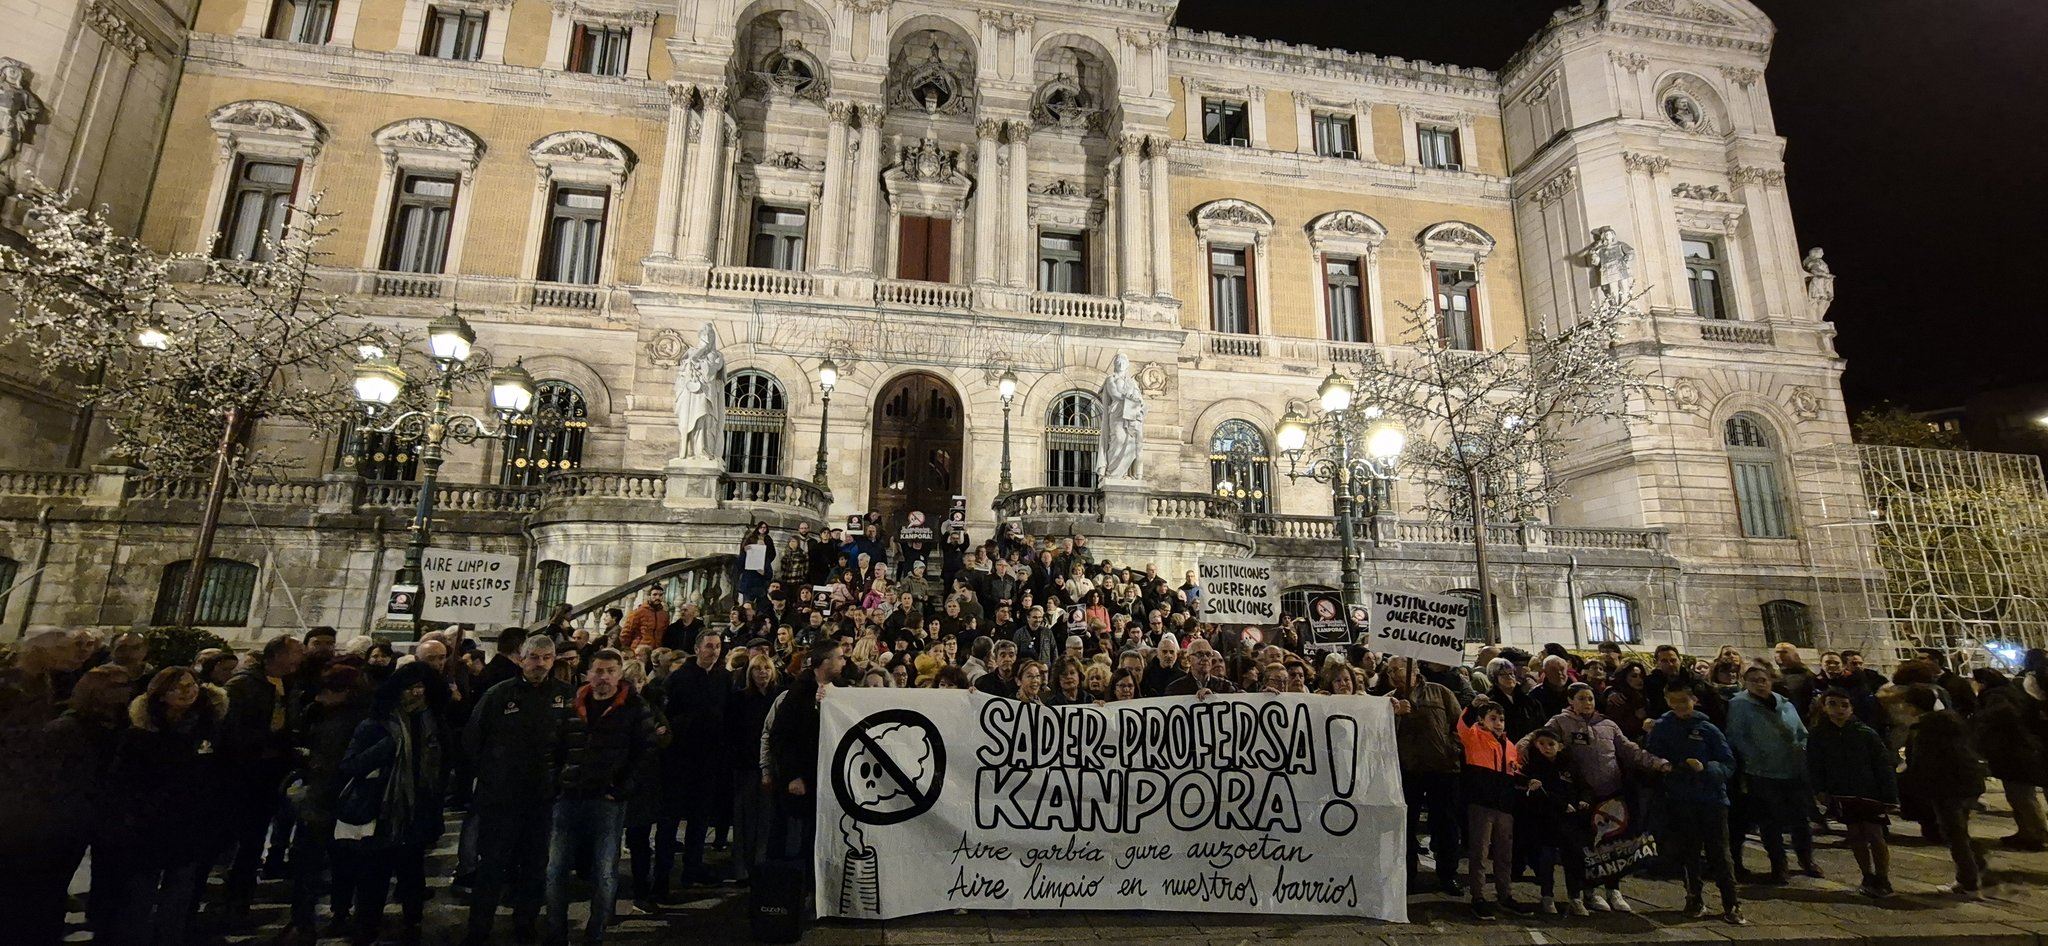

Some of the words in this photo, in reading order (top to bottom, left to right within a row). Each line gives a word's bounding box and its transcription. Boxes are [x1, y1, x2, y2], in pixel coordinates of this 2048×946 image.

[424, 557, 453, 573] AIRE
[457, 559, 500, 573] LIMPIO
[1199, 564, 1270, 580] INSTITUCIONES
[430, 579, 446, 593] EN
[451, 577, 511, 591] NUESTROS
[1208, 582, 1267, 598] QUEREMOS
[435, 595, 493, 608] BARRIOS
[1204, 598, 1273, 618] SOLUCIONES
[1375, 592, 1468, 617] INSTITUCIONES
[1386, 610, 1456, 630] QUEREMOS
[1378, 626, 1463, 652] SOLUCIONES
[976, 698, 1316, 775] SADER-PROFERSA
[951, 830, 1012, 865] Aire
[1020, 834, 1104, 868] garbia
[1115, 844, 1173, 869] gure
[1187, 833, 1313, 868] auzoetan
[948, 865, 1009, 900] Aire
[1023, 862, 1105, 907] limpio
[1117, 877, 1148, 896] en
[1162, 871, 1257, 906] nuestros
[1272, 865, 1357, 907] barrios
